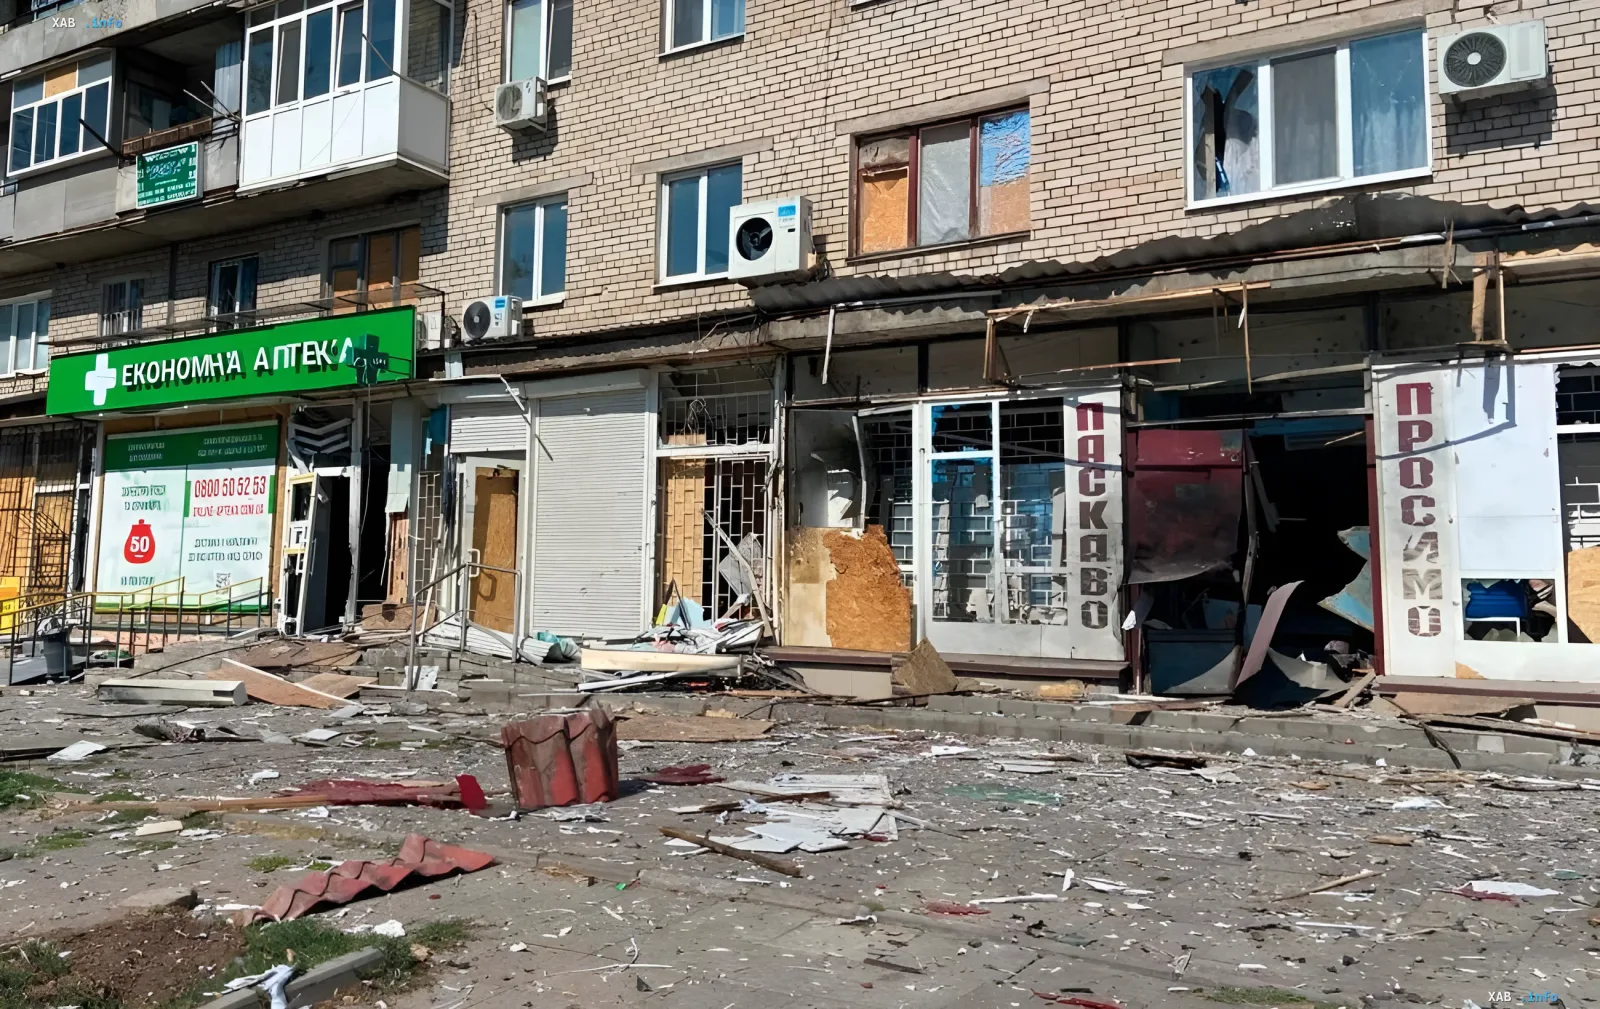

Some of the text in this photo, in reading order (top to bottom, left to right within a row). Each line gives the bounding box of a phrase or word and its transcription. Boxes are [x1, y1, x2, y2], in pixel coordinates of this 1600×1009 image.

[122, 350, 241, 386] ЕКОНОМНА
[194, 478, 220, 498] 0800
[237, 476, 251, 495] 52
[252, 475, 267, 495] 53
[129, 536, 150, 553] 50
